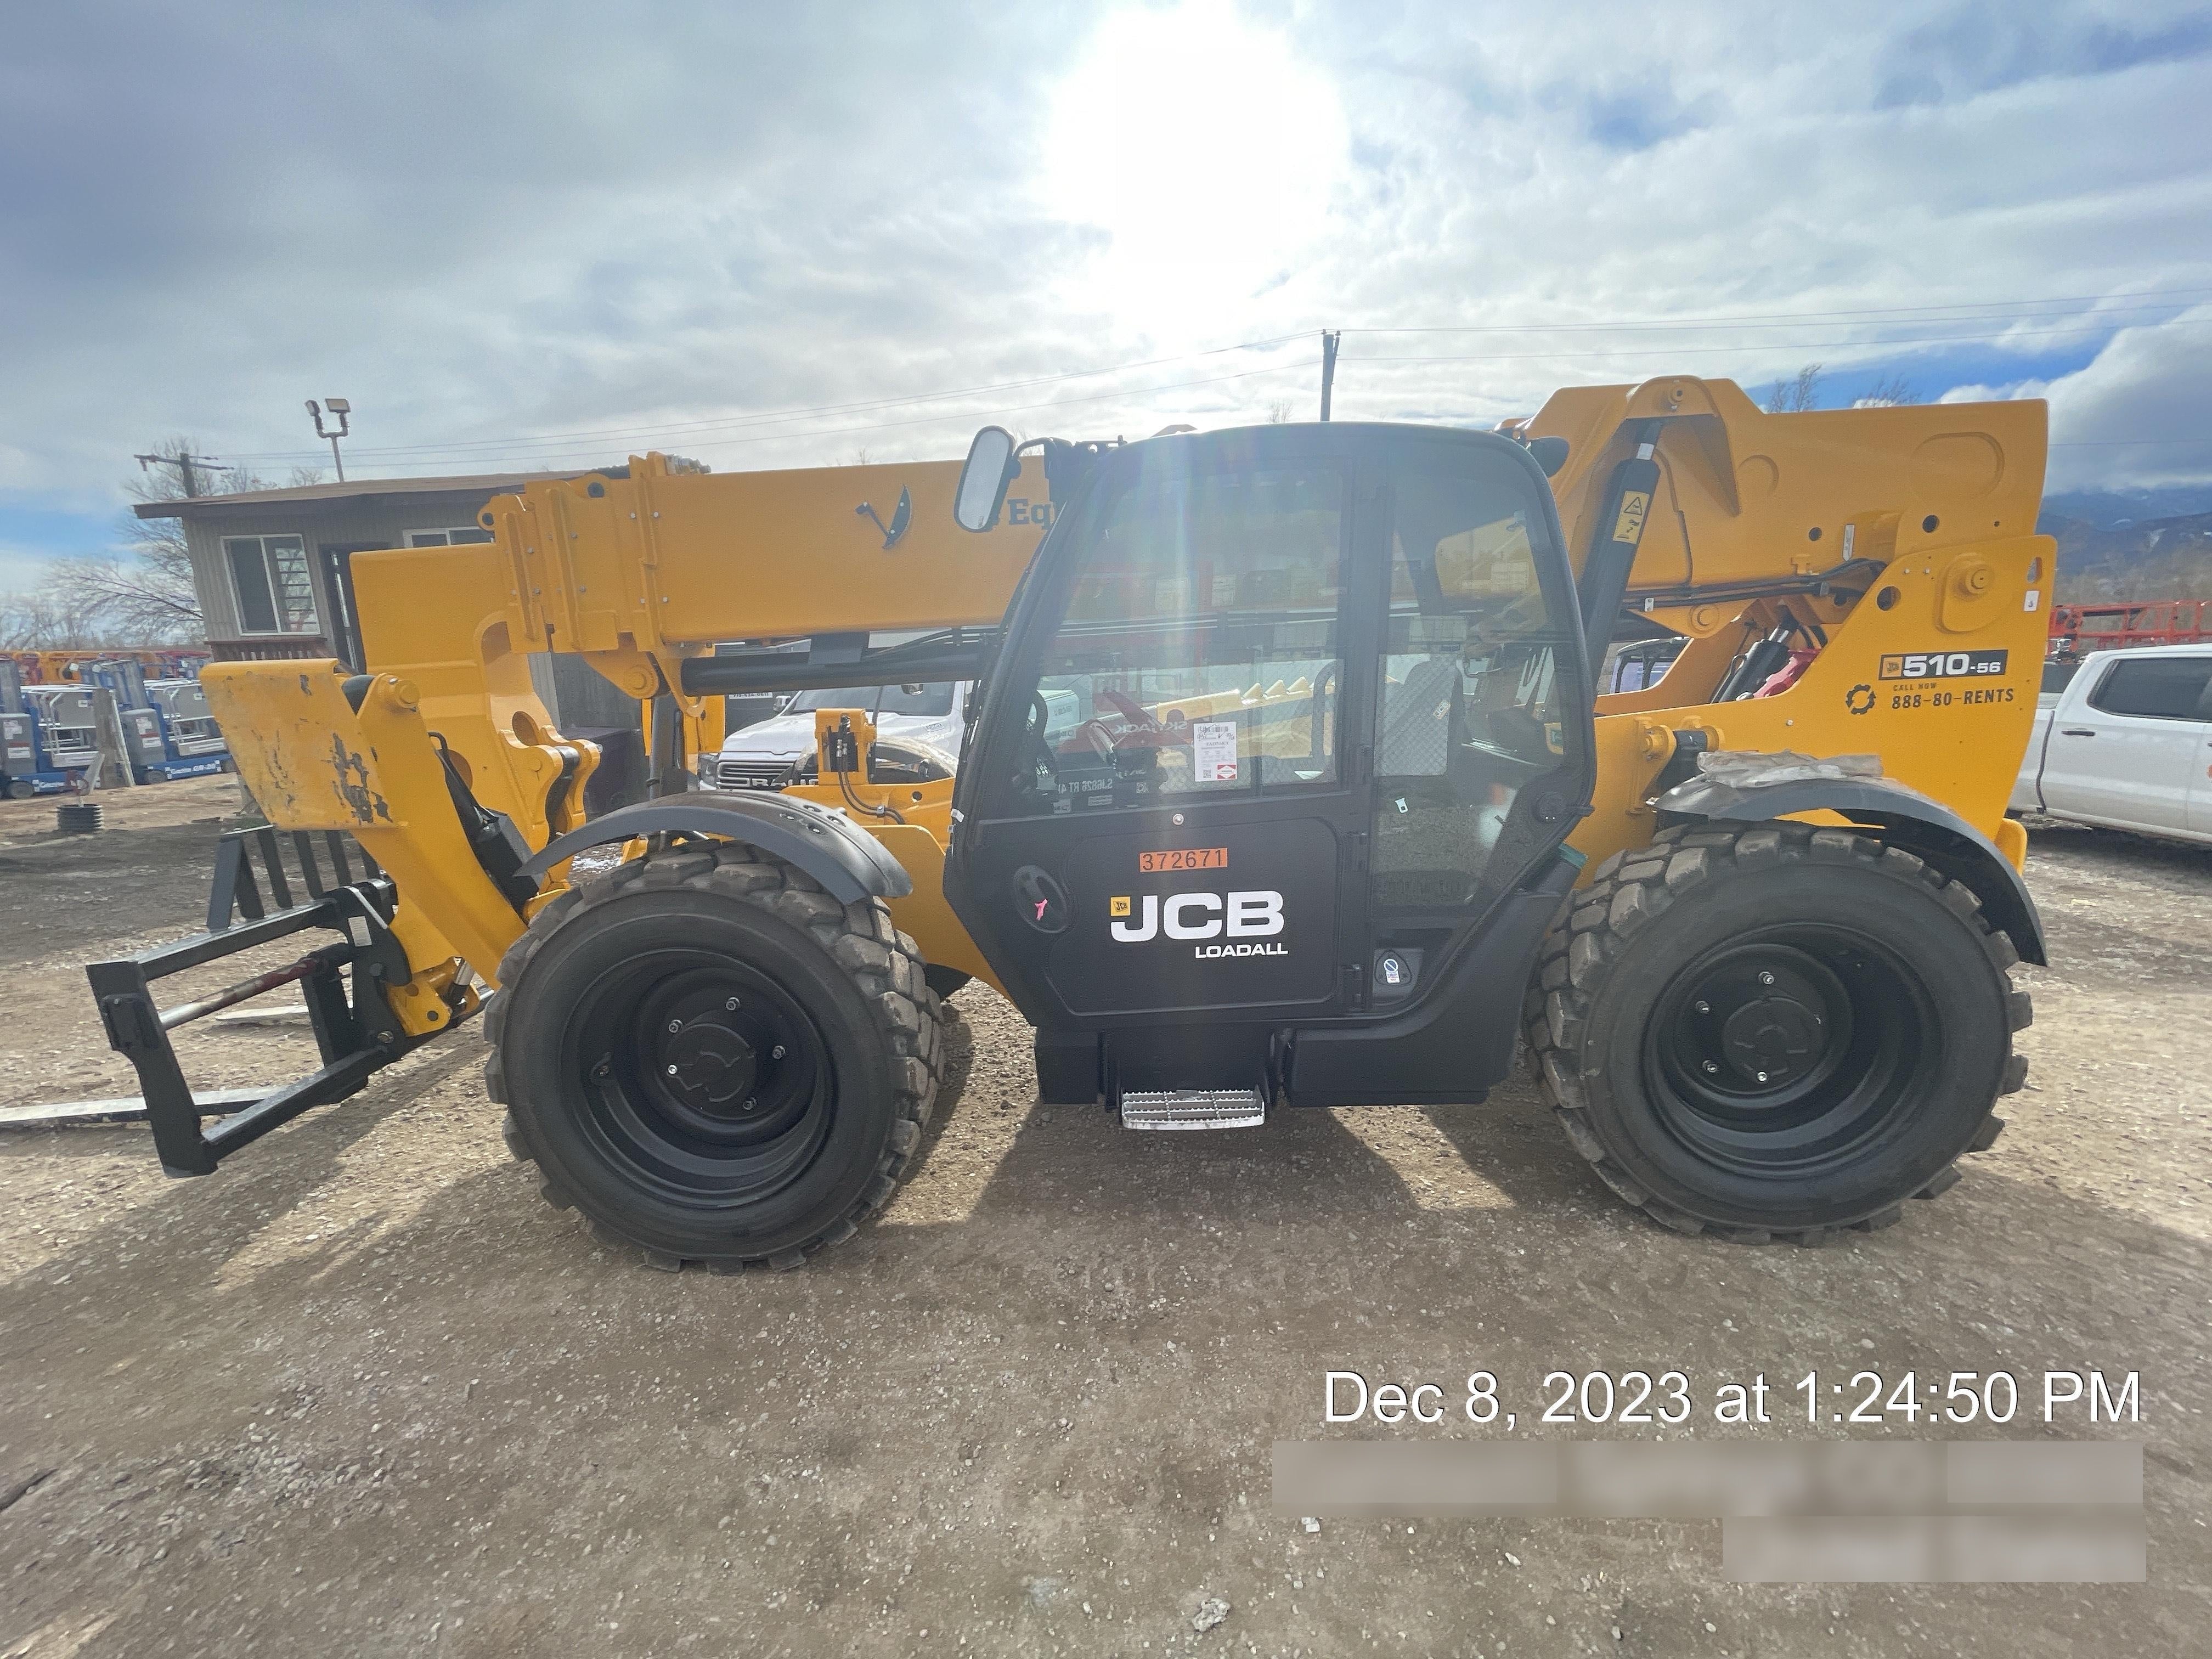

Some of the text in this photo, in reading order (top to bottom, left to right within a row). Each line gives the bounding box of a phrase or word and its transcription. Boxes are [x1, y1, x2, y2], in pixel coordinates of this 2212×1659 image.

[1007, 498, 1053, 530] Eq
[1902, 653, 2001, 677] 510-56
[1917, 682, 1937, 690] NOW
[1892, 688, 2015, 709] 888-80-RENTS
[1142, 850, 1223, 871] 372671
[1110, 890, 1285, 943] JCB
[1194, 942, 1289, 959] LOADALL
